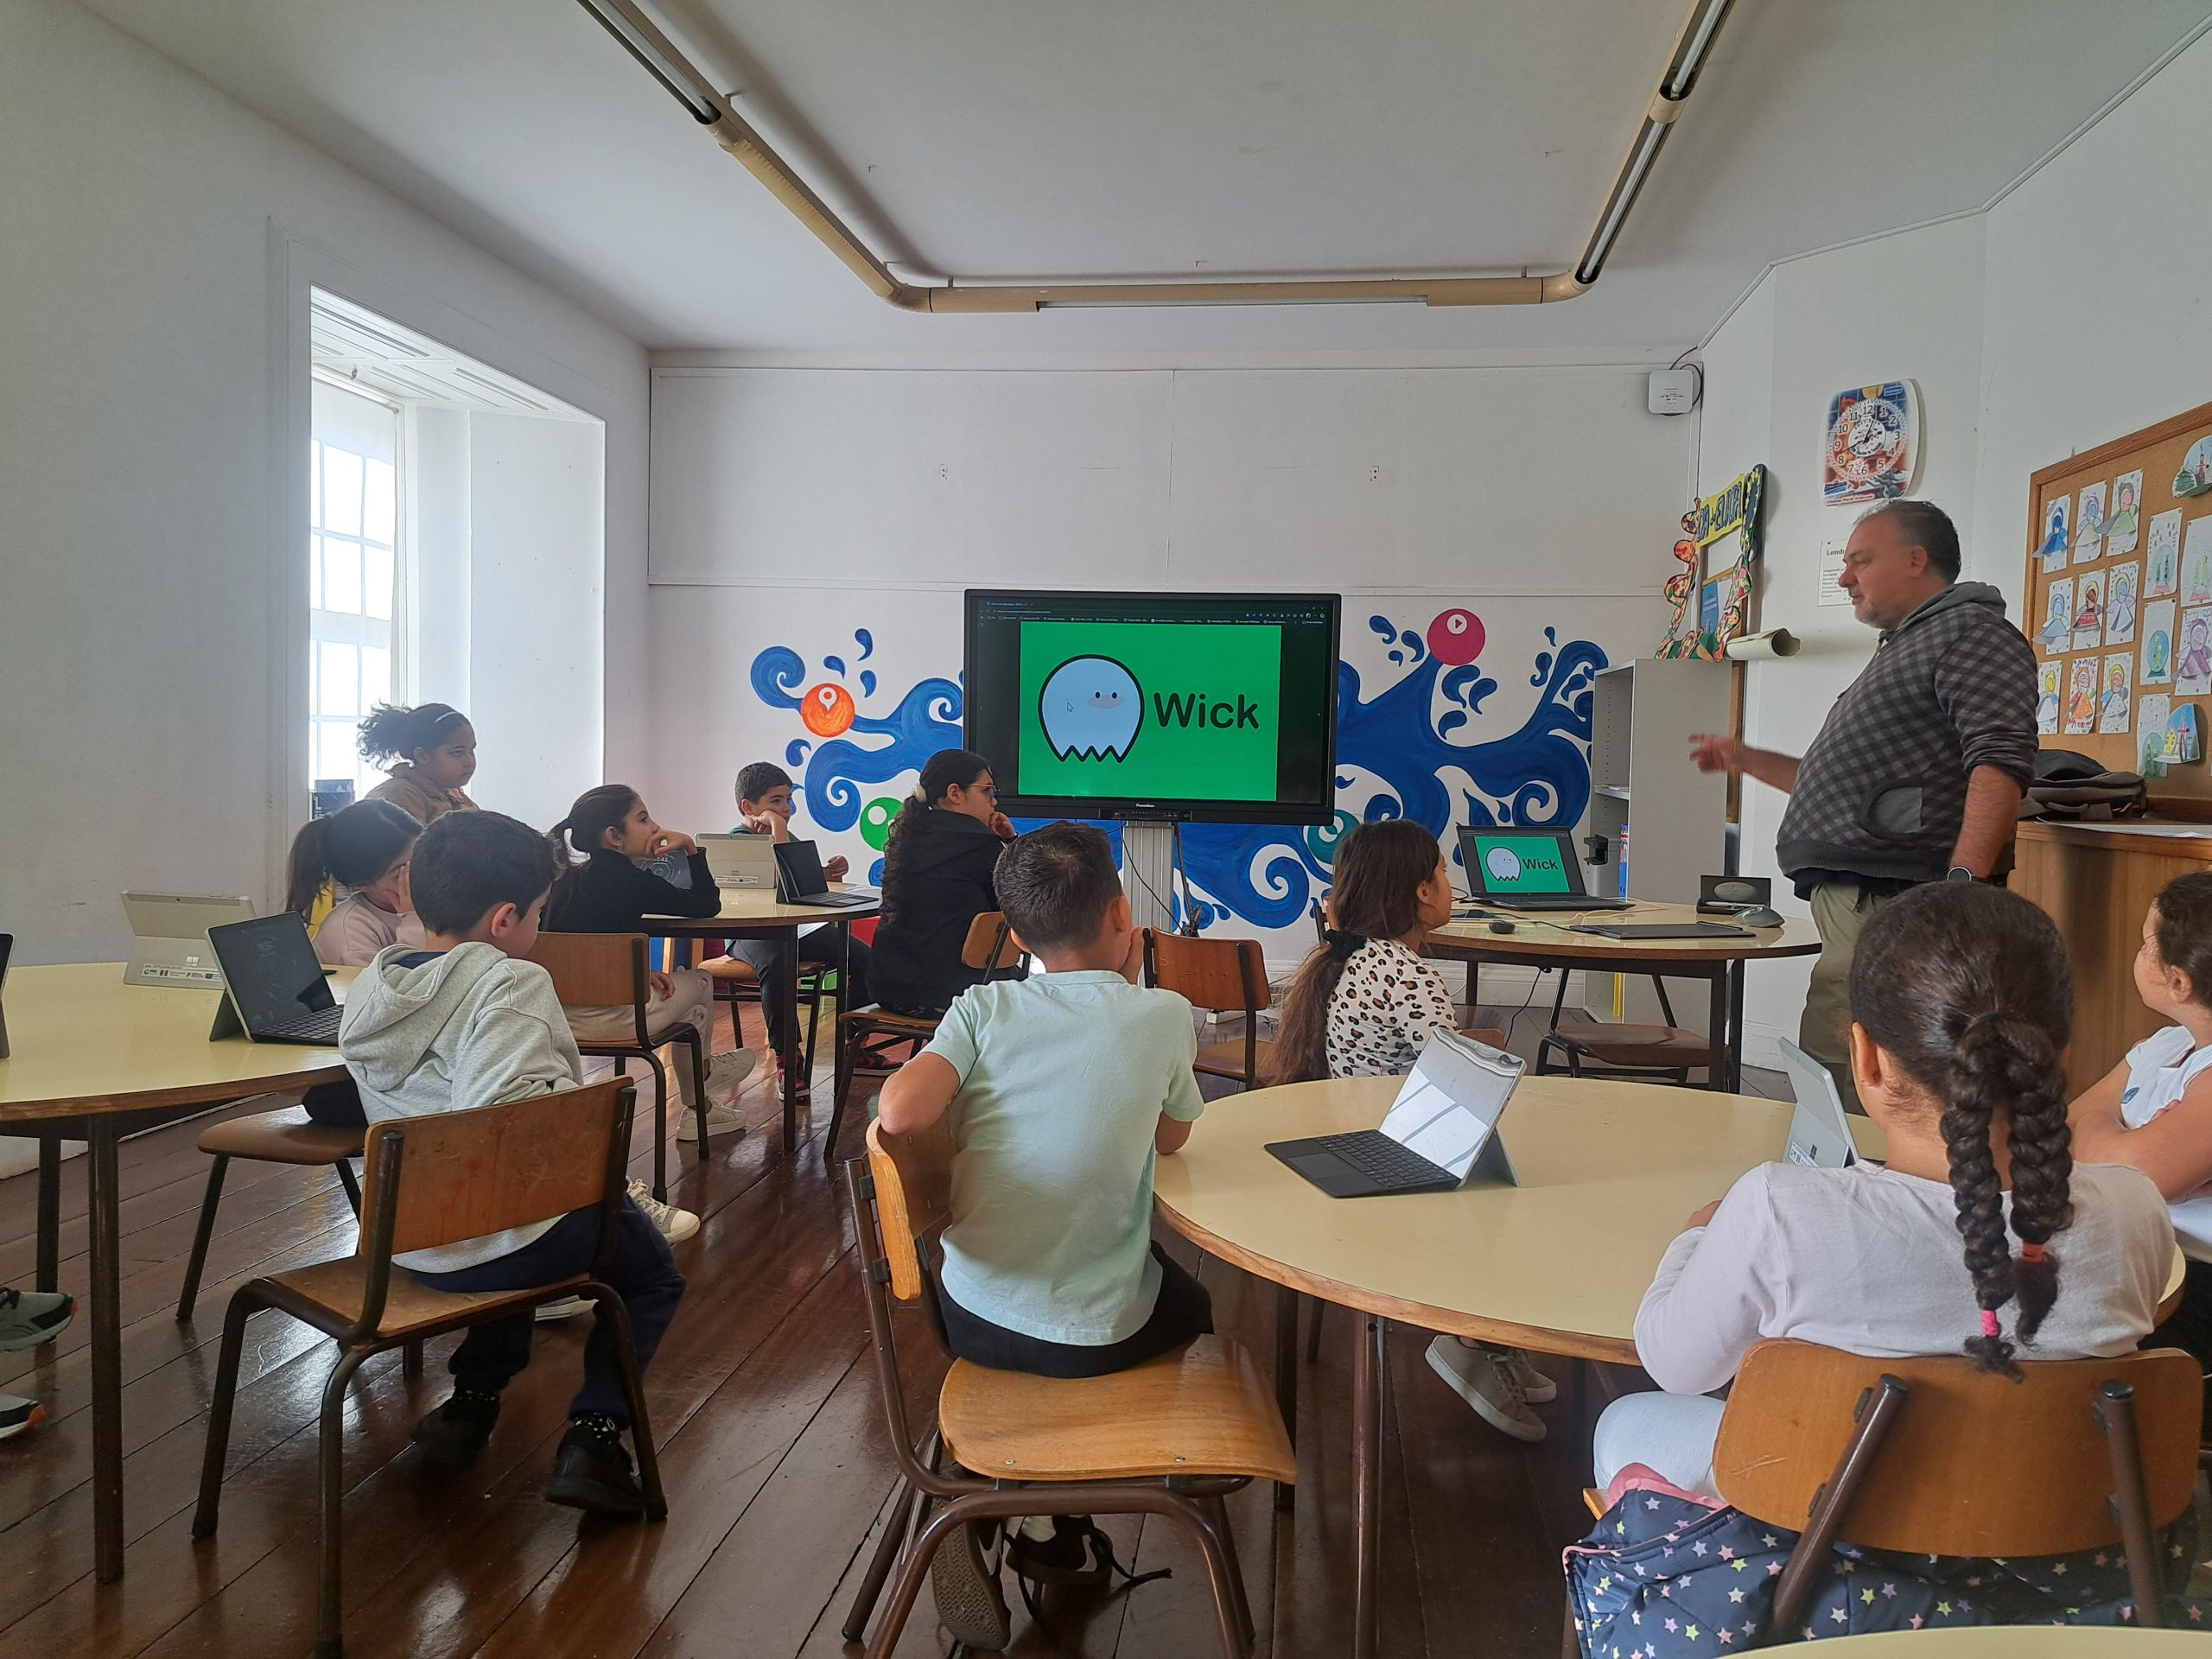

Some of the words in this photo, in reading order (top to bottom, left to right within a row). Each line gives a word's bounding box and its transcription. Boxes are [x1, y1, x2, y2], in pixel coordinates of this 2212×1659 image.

[1862, 404, 1873, 415] 12
[1882, 407, 1886, 416] 1
[1850, 411, 1858, 421] 11
[1839, 423, 1848, 433] 10
[1894, 431, 1901, 440] 3
[1834, 441, 1841, 449] 9
[1838, 455, 1845, 464] 8
[1878, 460, 1884, 468] 5
[1849, 464, 1854, 473] 7
[1861, 466, 1867, 474] 6
[1153, 692, 1260, 729] Wick
[1522, 858, 1559, 871] Wick
